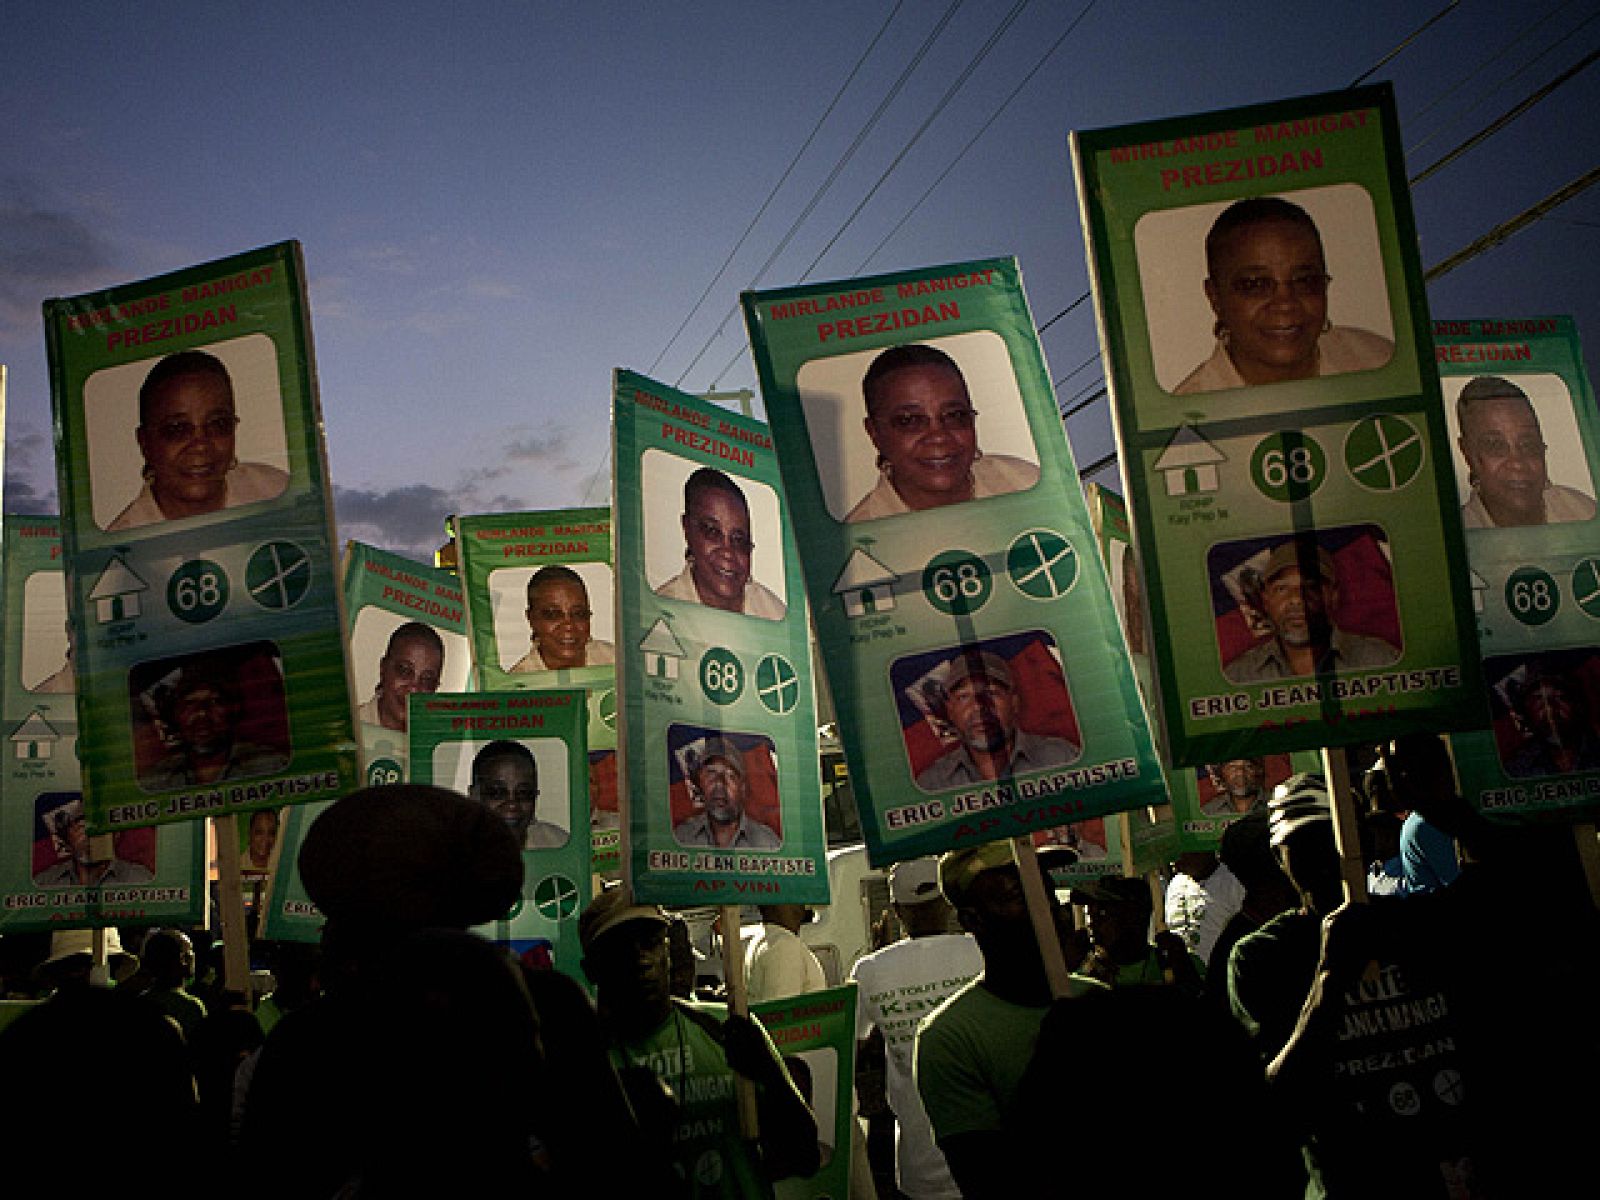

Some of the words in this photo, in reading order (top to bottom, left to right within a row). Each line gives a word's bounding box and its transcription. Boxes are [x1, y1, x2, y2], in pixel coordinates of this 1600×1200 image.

[1110, 130, 1239, 165] MIRLANDE
[1254, 110, 1369, 145] MANIGAT
[1161, 147, 1323, 192] PREZIDAN
[181, 266, 273, 303] MANIGAT
[769, 287, 885, 321] MIRLANDE
[896, 268, 995, 300] MANIGAT
[107, 304, 237, 352] PREZIDAN
[816, 301, 961, 343] PREZIDAN
[1435, 342, 1533, 363] REZIDAN
[634, 389, 712, 431] MIRLANDE
[717, 420, 773, 450] MANIGA
[661, 422, 755, 468] PREZIDAN
[1261, 446, 1317, 488] 68
[502, 541, 588, 558] PREZIDAN
[176, 573, 221, 610] 68
[365, 559, 430, 592] MIRLANDE
[931, 562, 983, 602] 68
[382, 584, 463, 624] PREZIDAN
[1513, 579, 1551, 613] 68
[704, 658, 739, 694] 68
[1190, 694, 1249, 721] ERIC
[1256, 682, 1322, 711] JEAN
[1329, 665, 1461, 700] BAPTISTE
[452, 714, 545, 732] PREZIDAN
[107, 801, 161, 826] ERIC
[166, 788, 224, 816] JEAN
[228, 770, 341, 805] BAPTISTE
[884, 800, 946, 831] ERIC
[950, 784, 1016, 816] JEAN
[1015, 757, 1140, 802] BAPTISTE
[1480, 787, 1527, 811] ERIC
[647, 850, 691, 871] ERIC
[692, 852, 735, 873] JEAN
[737, 855, 817, 877] BAPTISTE
[3, 893, 47, 909] ERIC
[52, 891, 99, 906] JEAN
[103, 888, 189, 904] BAPTISTE
[693, 879, 726, 894] AP
[732, 879, 782, 895] VINI
